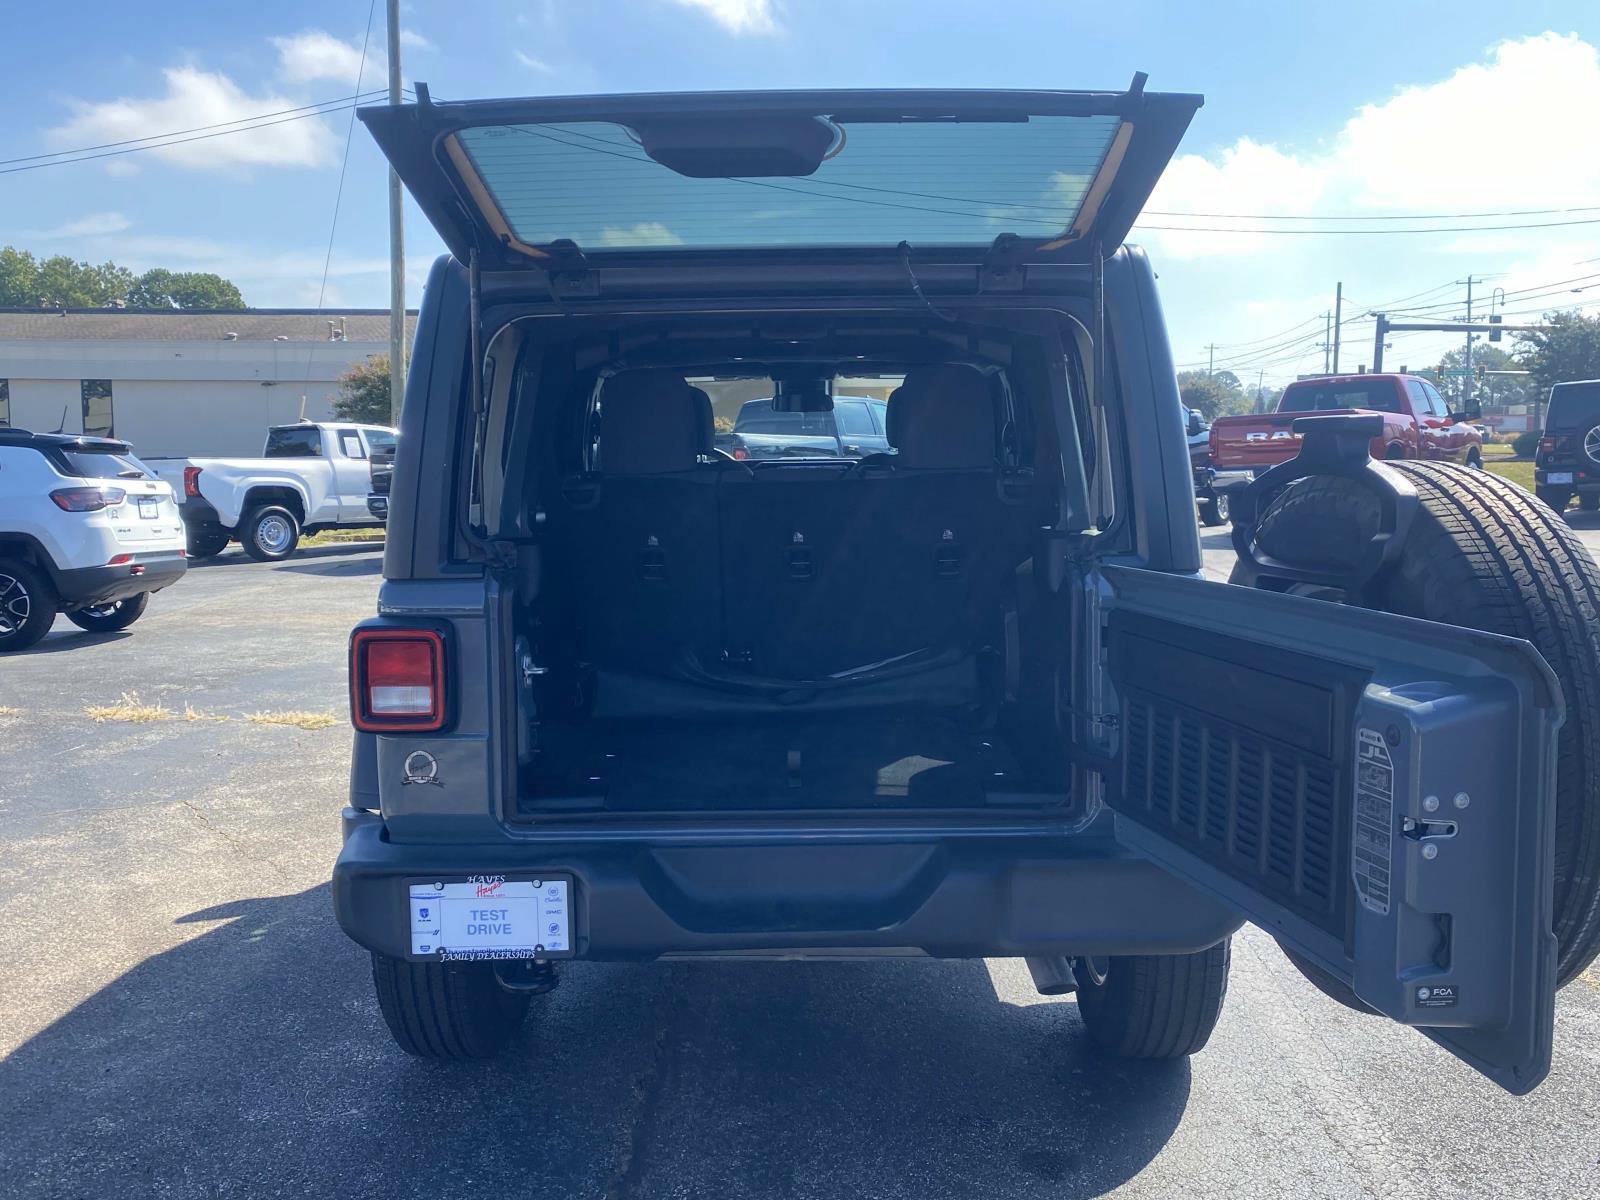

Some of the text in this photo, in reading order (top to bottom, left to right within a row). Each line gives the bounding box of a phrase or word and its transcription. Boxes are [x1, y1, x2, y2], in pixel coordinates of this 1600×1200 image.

[469, 909, 509, 921] TEST
[467, 923, 512, 936] DRIVE
[440, 950, 536, 963] FAMILY DEALERSHIPS
[1433, 988, 1453, 996] FCA
